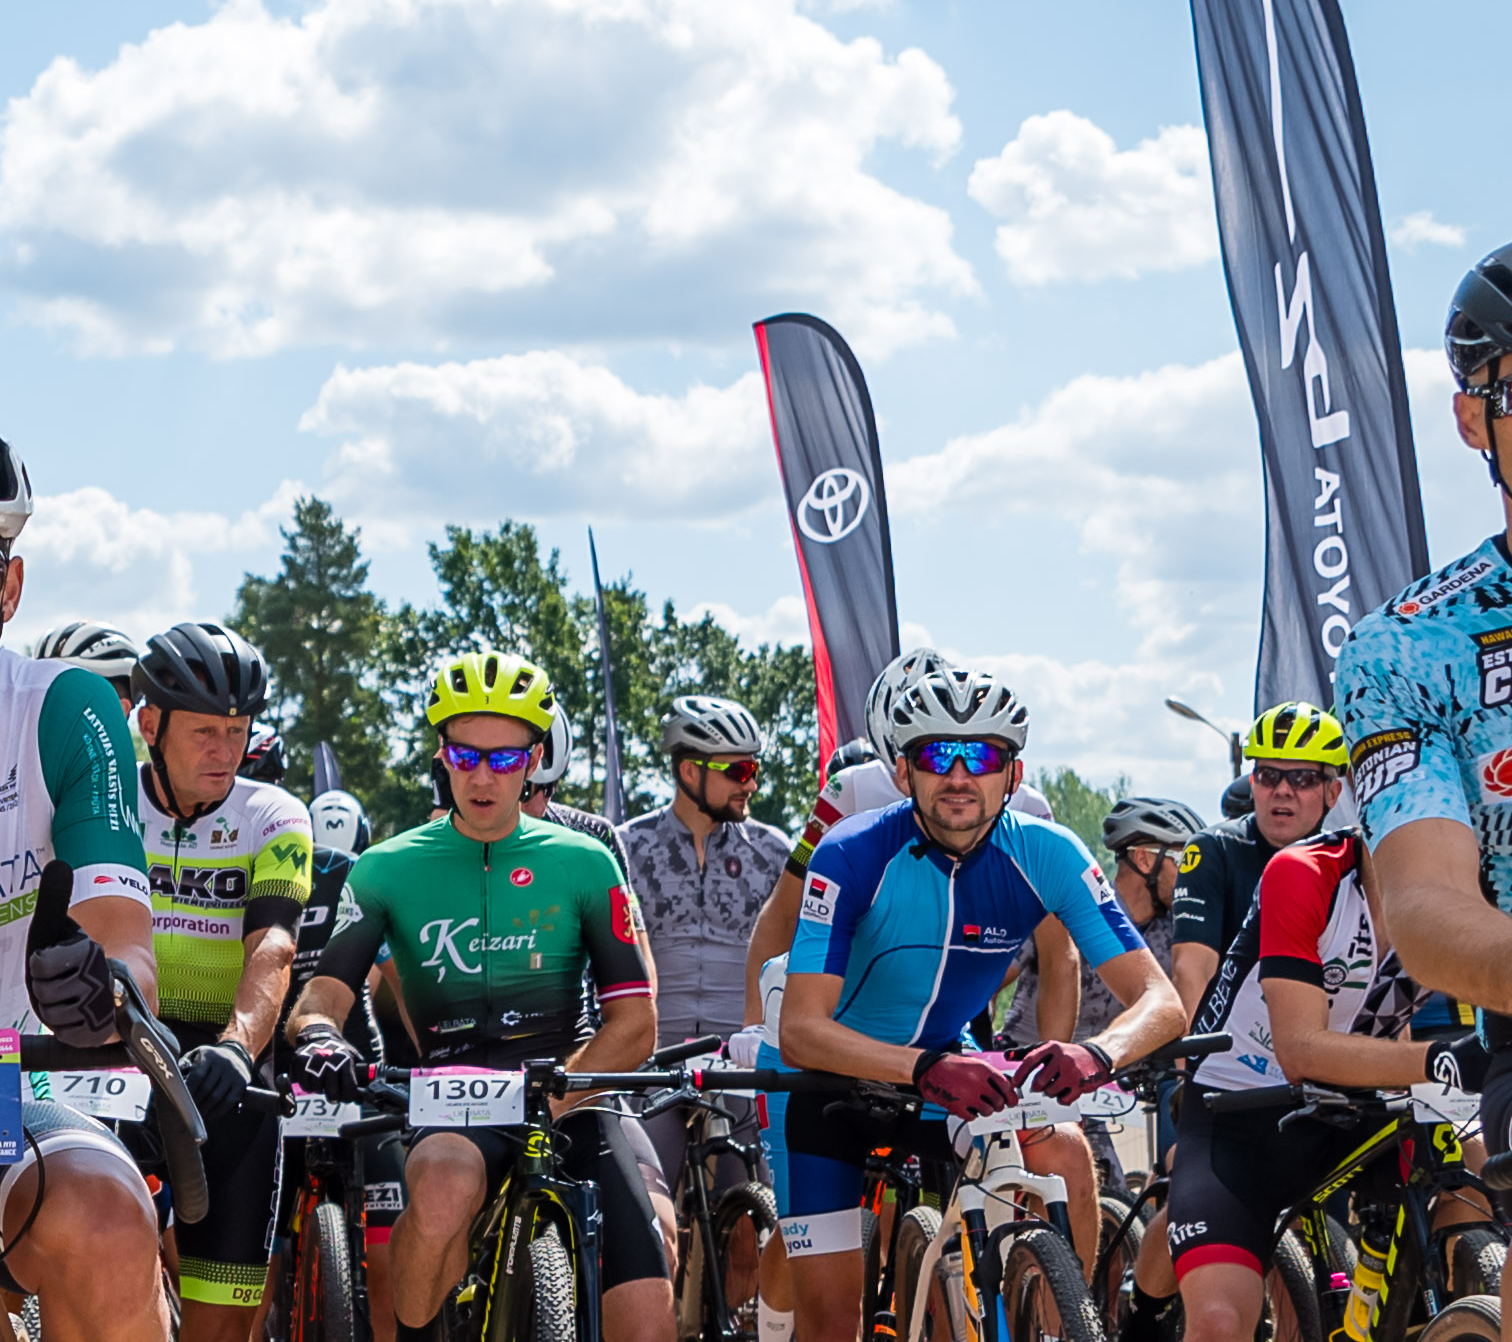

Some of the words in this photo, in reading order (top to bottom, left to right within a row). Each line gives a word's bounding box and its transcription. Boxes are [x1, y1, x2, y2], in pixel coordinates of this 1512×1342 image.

[1418, 561, 1492, 606] GARDENA
[139, 1036, 175, 1081] GRX
[62, 1075, 127, 1096] 710
[425, 1079, 512, 1101] 1307
[295, 1099, 342, 1117] 737
[1312, 1165, 1364, 1204] SCOTT
[786, 1238, 813, 1254] you
[232, 1287, 253, 1304] D8
